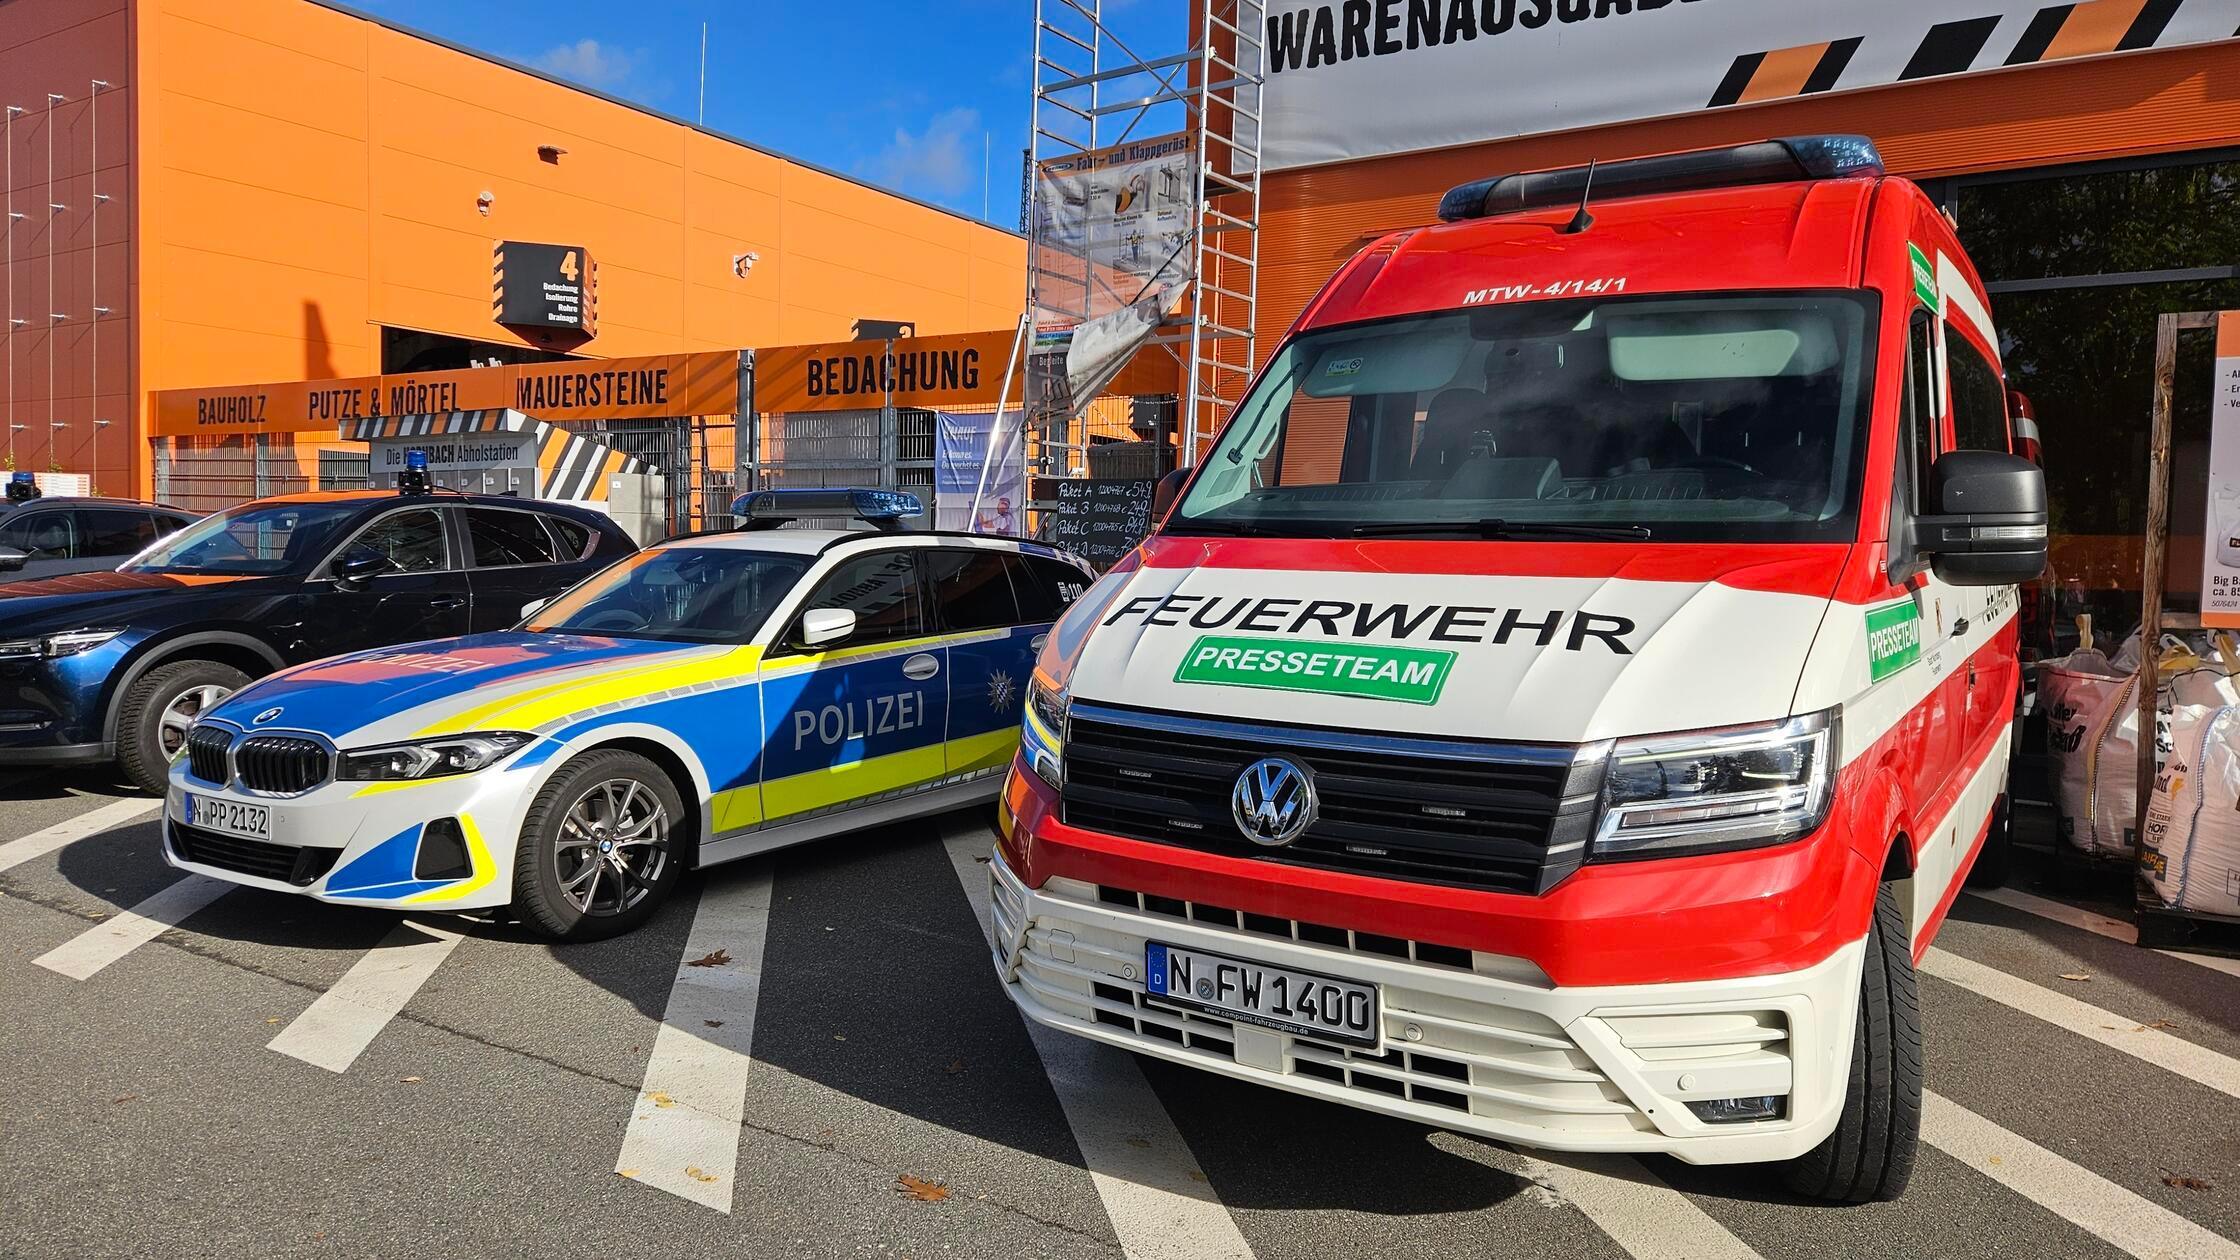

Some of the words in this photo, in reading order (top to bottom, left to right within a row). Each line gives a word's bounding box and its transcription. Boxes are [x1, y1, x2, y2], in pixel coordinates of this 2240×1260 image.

[1267, 0, 1703, 73] WARENAUS
[1109, 149, 1126, 164] und
[1130, 136, 1190, 160] Klappgerüst
[560, 251, 579, 281] 4
[543, 282, 579, 294] Bedachung
[1463, 277, 1627, 305] MTW-4/14/1
[558, 303, 578, 313] Rohre
[808, 348, 979, 397] BEDACHUNG
[309, 389, 362, 420] PUTZE
[370, 388, 380, 417] &
[391, 380, 461, 416] MÖRTEL
[516, 369, 668, 410] MAUERSTEINE
[198, 395, 266, 425] BAUHOLZ
[387, 449, 401, 465] Die
[403, 444, 454, 465] HBACH
[457, 443, 519, 463] Abholstation
[1058, 482, 1082, 497] Paket
[1084, 485, 1092, 498] A
[1057, 501, 1078, 515] Paket
[1057, 519, 1080, 535] Paket
[1080, 521, 1089, 535] C
[2212, 588, 2228, 596] ca.
[2213, 575, 2229, 587] Big
[1102, 594, 1638, 655] FEUERWEHR
[1869, 617, 1919, 663] PRESSETEAM
[1192, 645, 1439, 687] PRESSETEAM
[794, 690, 924, 751] POLIZEI
[193, 798, 202, 823] N
[210, 802, 227, 827] PP
[231, 805, 266, 835] 2132
[1154, 973, 1162, 985] D
[1171, 953, 1192, 995] N
[1217, 964, 1263, 1010] FW
[1272, 976, 1369, 1031] 1400
[1203, 1006, 1309, 1035] www.compoint-fahrzeugbau.de
